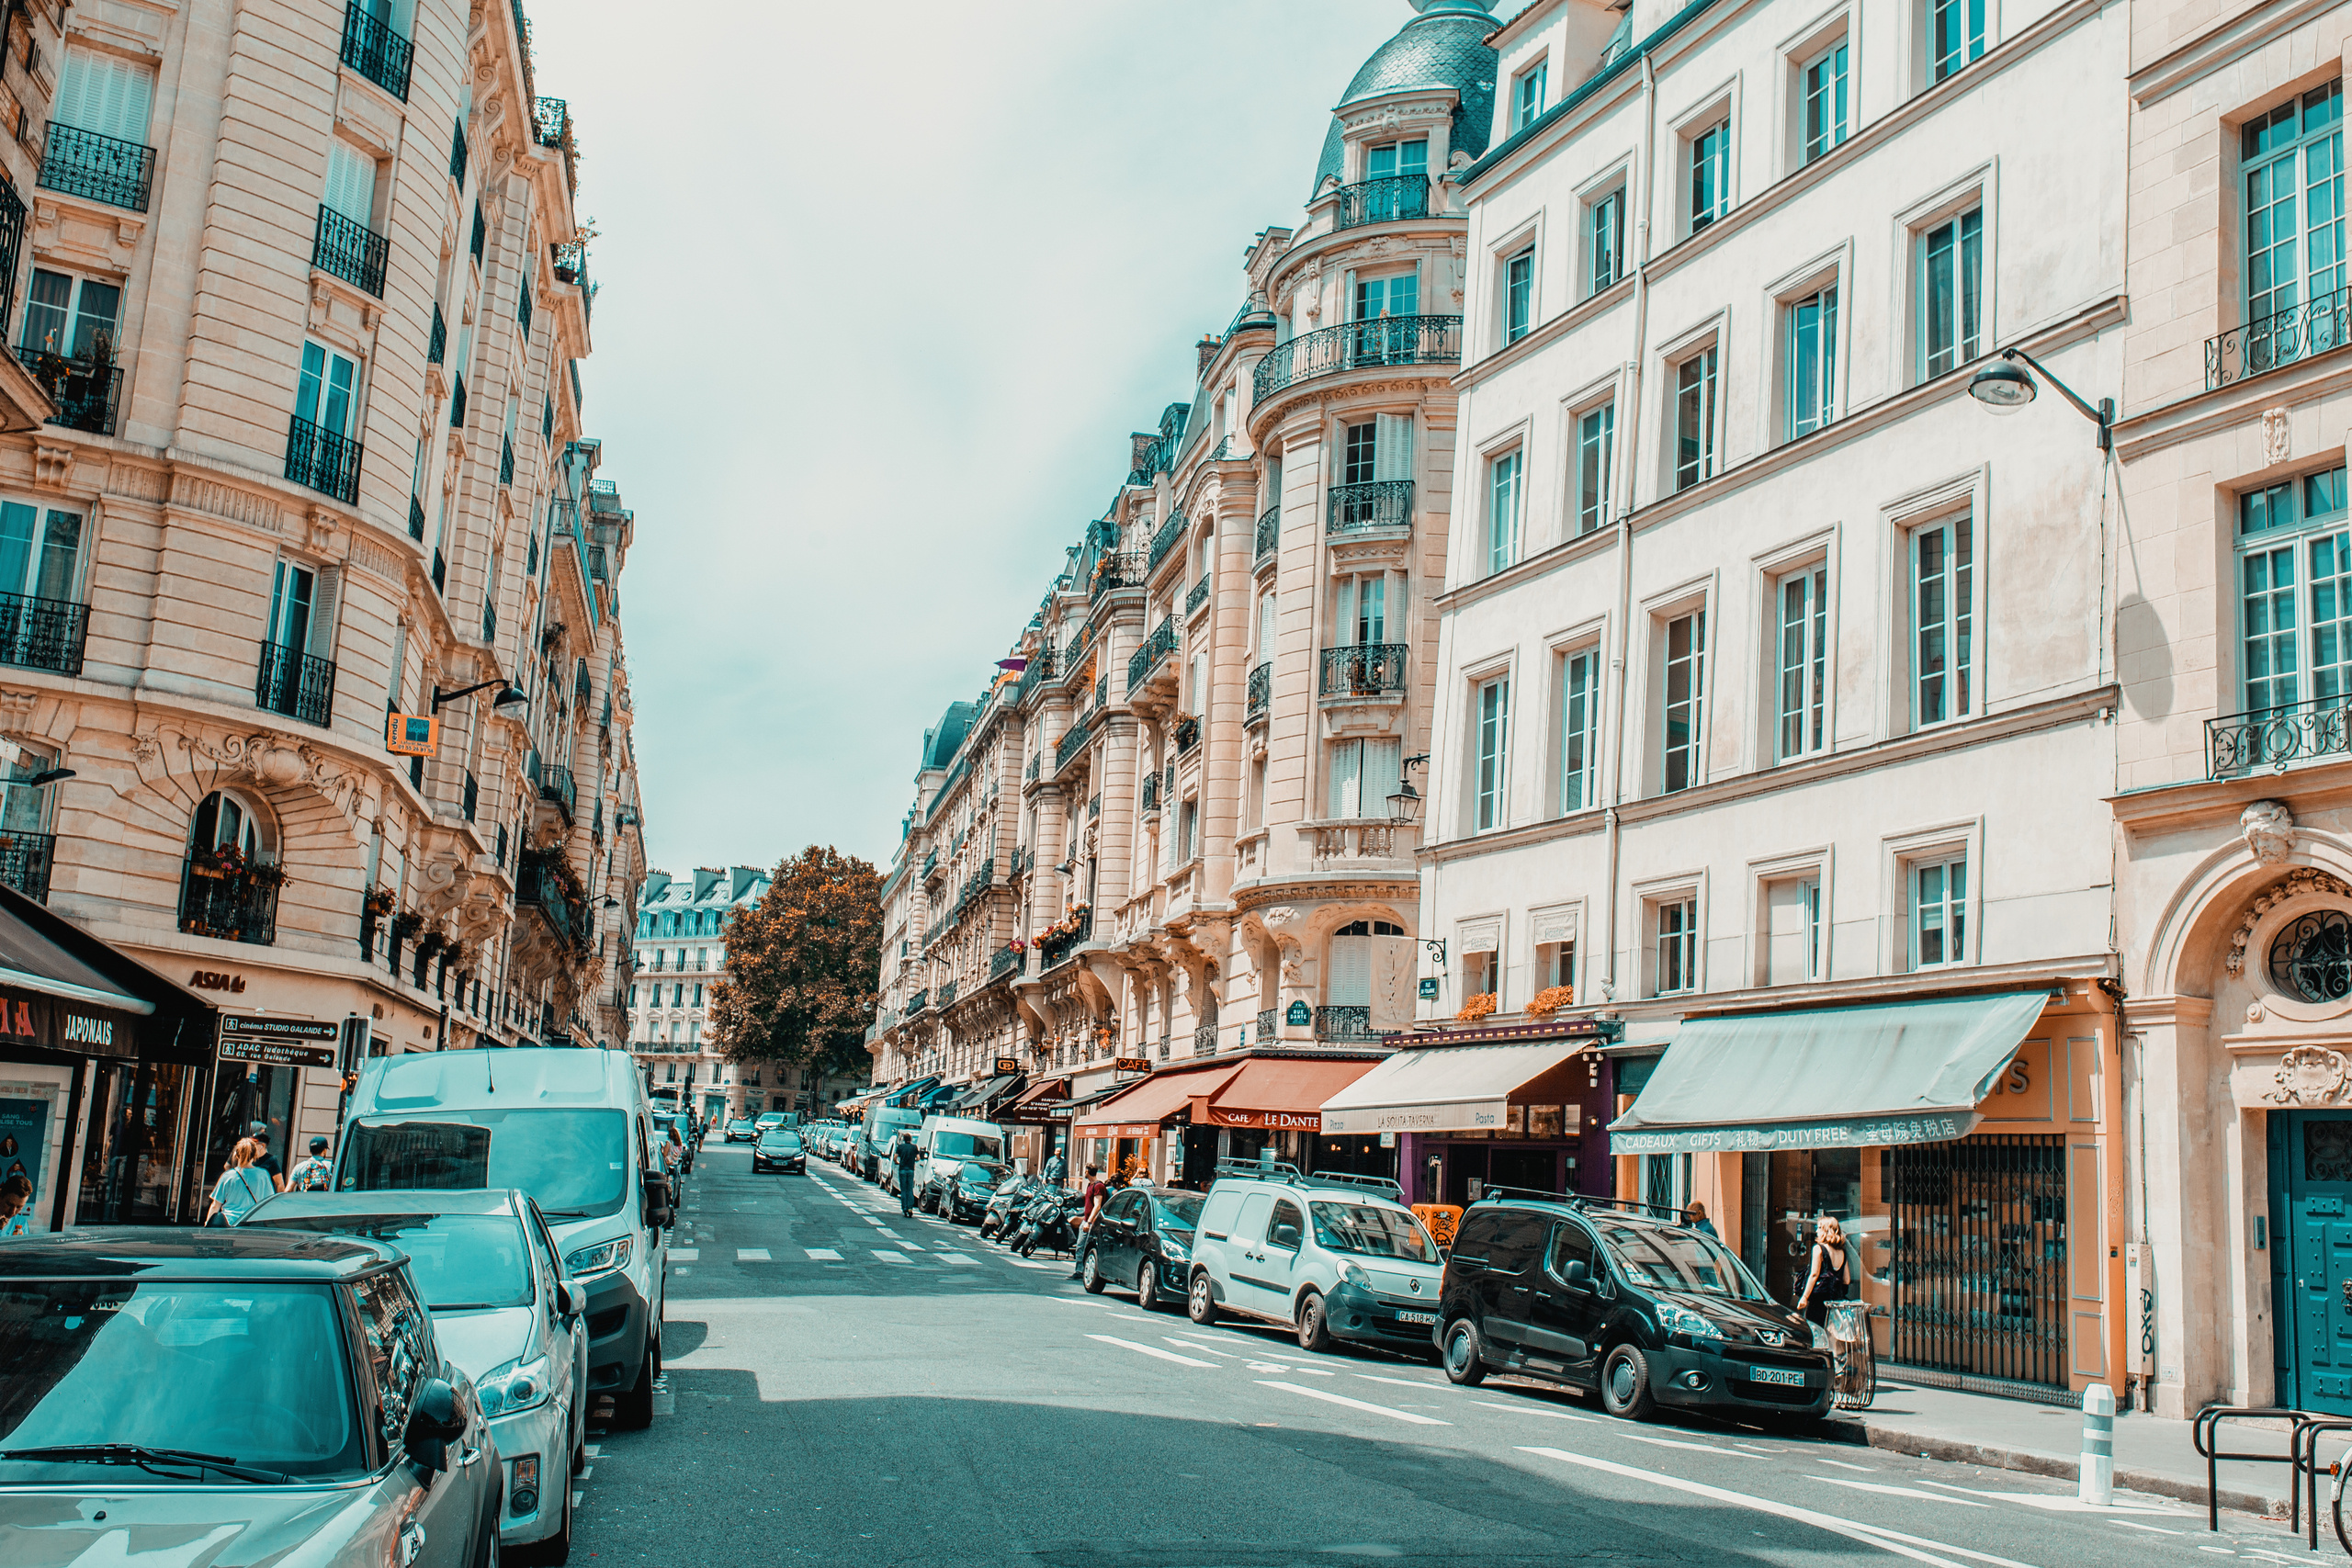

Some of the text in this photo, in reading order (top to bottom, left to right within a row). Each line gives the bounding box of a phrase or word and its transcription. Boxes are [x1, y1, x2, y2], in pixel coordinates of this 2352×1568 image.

[188, 970, 231, 991] ASIA
[65, 1014, 113, 1045] JAPONAIS
[239, 1022, 322, 1035] cinéma STUDIO GALANDE
[236, 1043, 309, 1056] ADAC ludothèque
[264, 1054, 291, 1062] Galande
[1227, 1112, 1319, 1127] CAFE LE DANTE
[1329, 1119, 1344, 1130] Pizza
[1377, 1116, 1385, 1128] LA
[1408, 1114, 1434, 1127] TAVERNA
[1476, 1112, 1495, 1124] Pasta
[1778, 1126, 1848, 1144] DUTY FREE
[1865, 1118, 1958, 1142] 圣母院免税店
[1625, 1133, 1721, 1149] CADEAUX GIFTS
